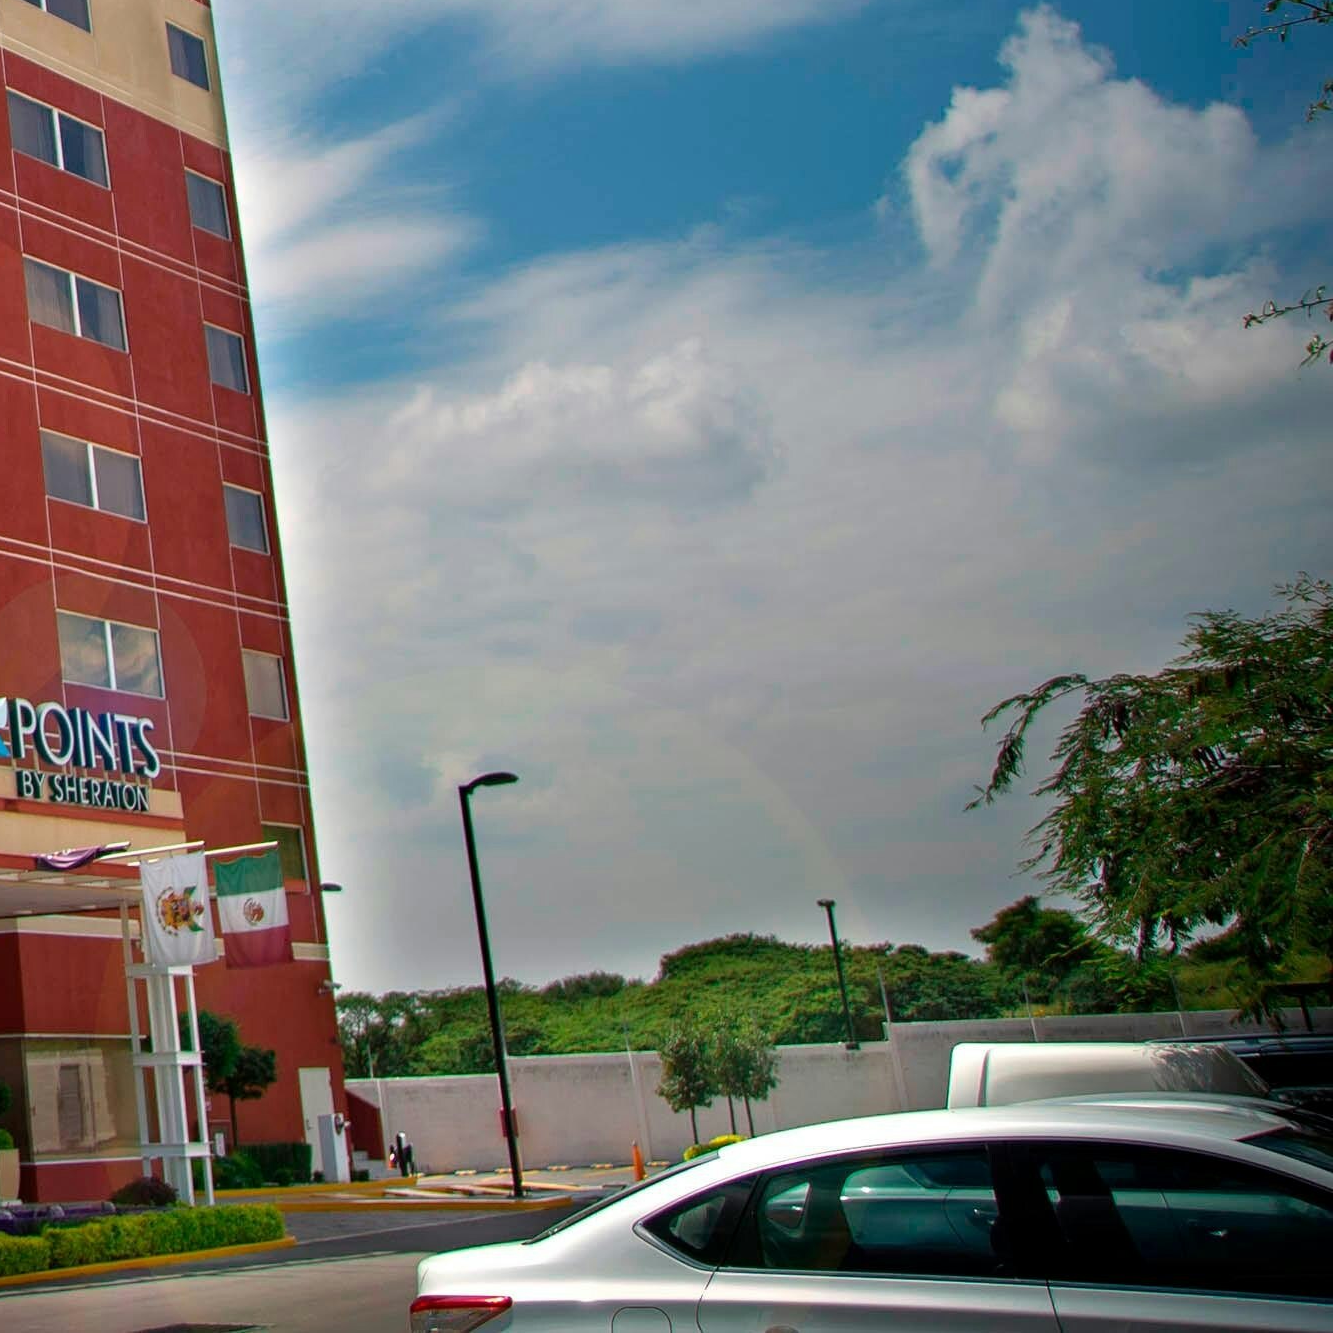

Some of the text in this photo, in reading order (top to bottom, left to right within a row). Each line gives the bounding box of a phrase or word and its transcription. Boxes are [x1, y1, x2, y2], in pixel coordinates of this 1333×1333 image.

[9, 698, 160, 778] POINTS
[17, 770, 150, 812] BY SHERATON
